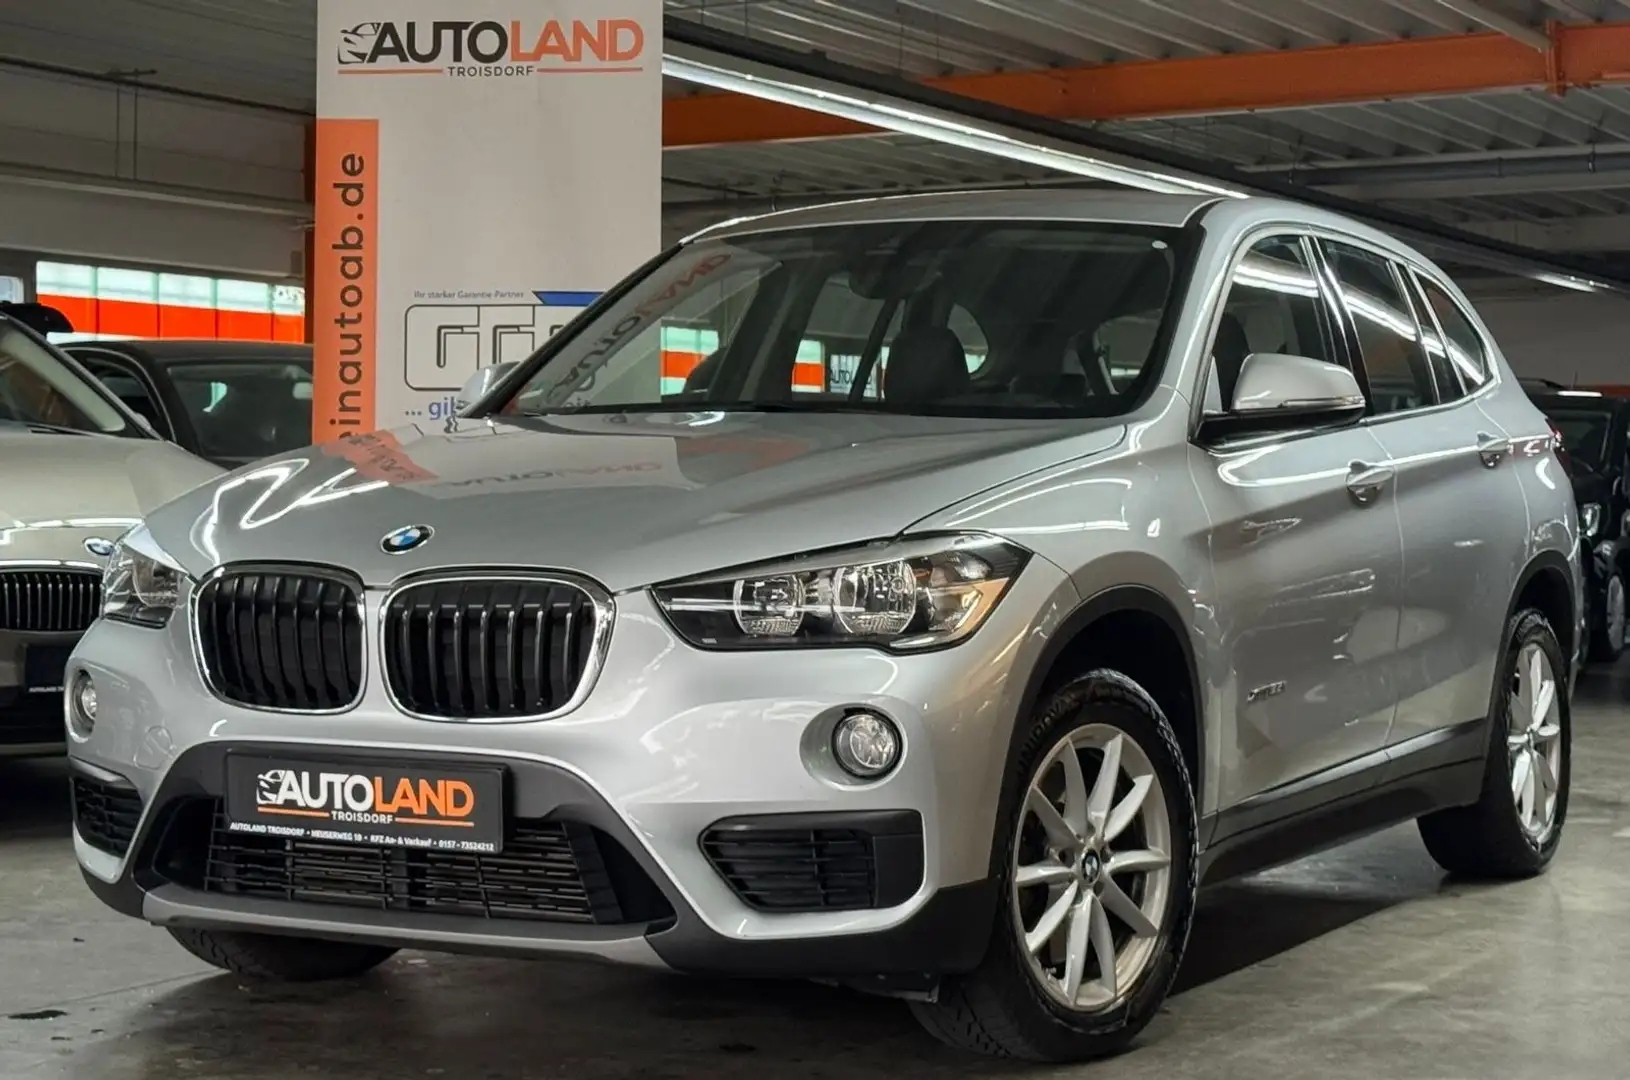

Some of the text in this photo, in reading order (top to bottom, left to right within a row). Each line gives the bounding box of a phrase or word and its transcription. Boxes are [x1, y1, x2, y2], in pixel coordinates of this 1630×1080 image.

[366, 19, 644, 64] AUTOLAND
[446, 65, 535, 78] TROISDORF
[276, 769, 475, 817] AUTOLAND
[330, 810, 393, 825] TROISDORF
[229, 822, 267, 833] AUTOLAND
[267, 825, 305, 837] TROISDORF
